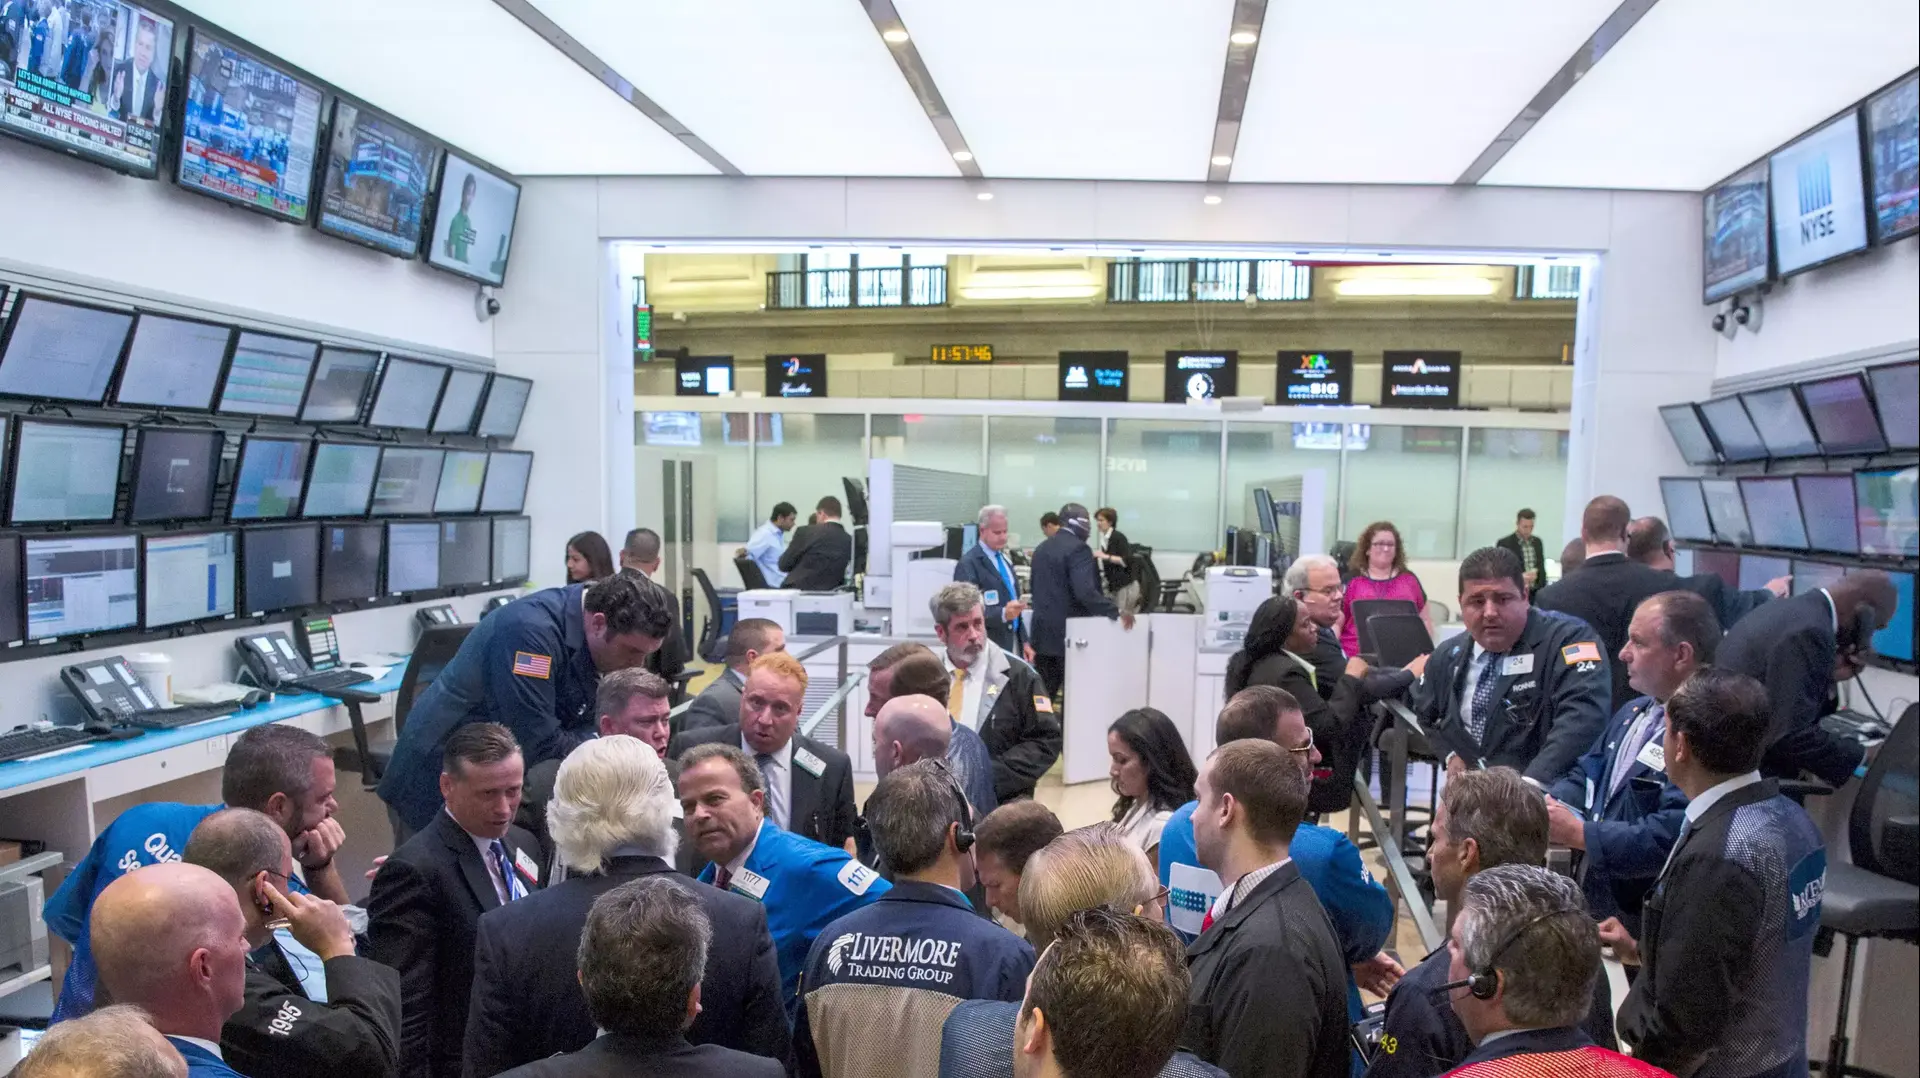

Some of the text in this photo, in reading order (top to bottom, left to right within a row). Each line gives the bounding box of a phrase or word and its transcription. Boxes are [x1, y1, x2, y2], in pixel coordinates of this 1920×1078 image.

[9, 87, 40, 104] BREAKING
[15, 96, 33, 110] NEWS
[42, 102, 55, 115] ALL
[55, 106, 72, 120] NYSE
[72, 112, 99, 129] TRADING
[100, 121, 122, 137] HALTED
[1800, 210, 1835, 245] NYSE
[932, 346, 992, 361] 11:57:46
[1577, 661, 1596, 672] 24
[743, 871, 762, 886] 1177
[850, 932, 961, 968] LIVERMORE
[847, 962, 953, 985] TRADING GROUP
[267, 1000, 302, 1036] 1995
